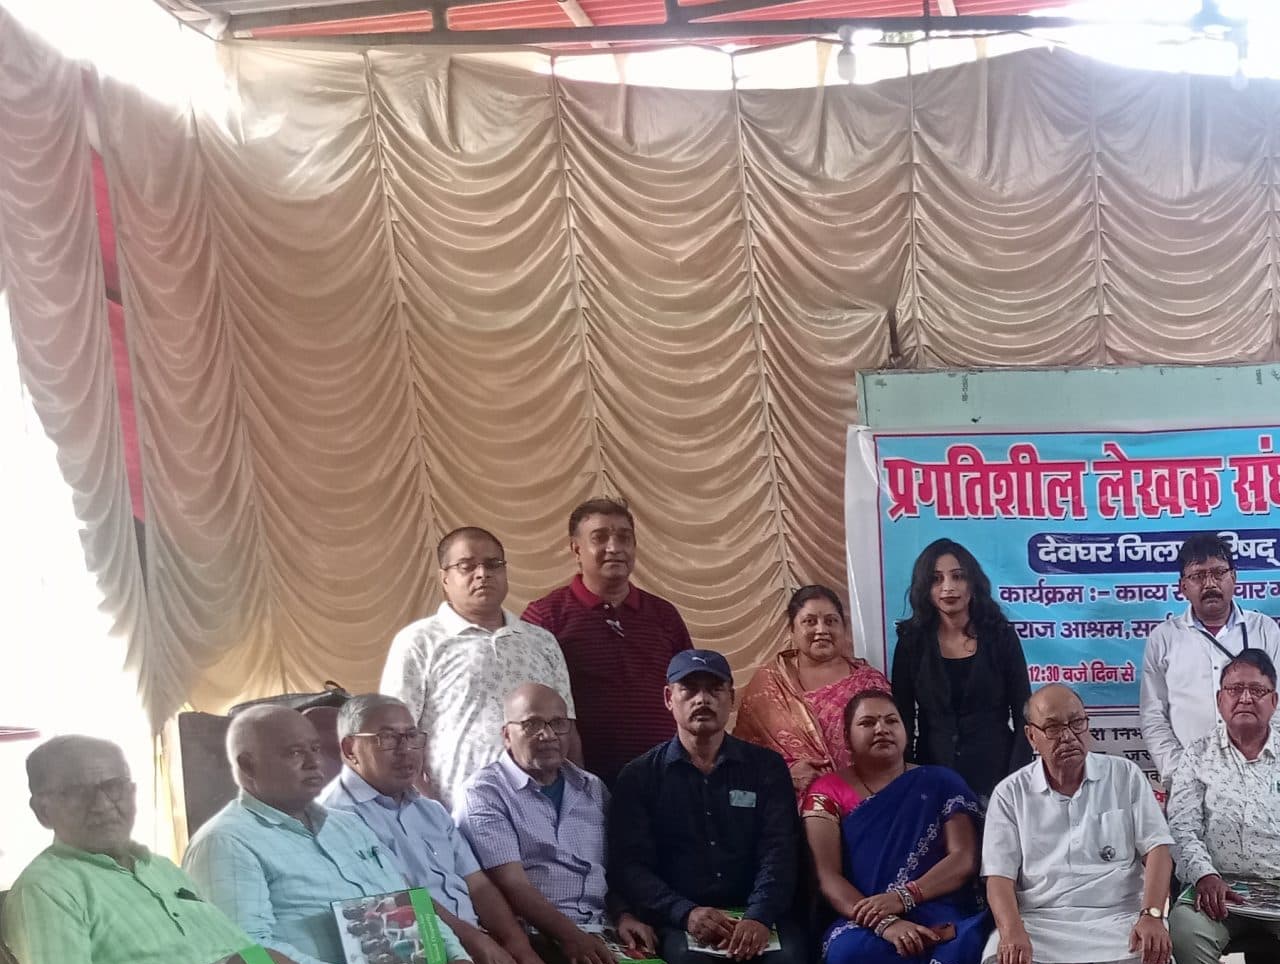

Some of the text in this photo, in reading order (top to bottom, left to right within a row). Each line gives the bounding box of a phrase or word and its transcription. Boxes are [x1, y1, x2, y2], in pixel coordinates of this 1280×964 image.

[882, 443, 1087, 520] प्रगतिशील
[1092, 441, 1223, 518] लेखक
[1037, 535, 1113, 563] देवघर
[999, 579, 1084, 605] कार्यक्रम
[1115, 584, 1168, 602] काव्य
[1008, 621, 1056, 639] राज
[1029, 660, 1135, 682] 12:30 बजे दिन से
